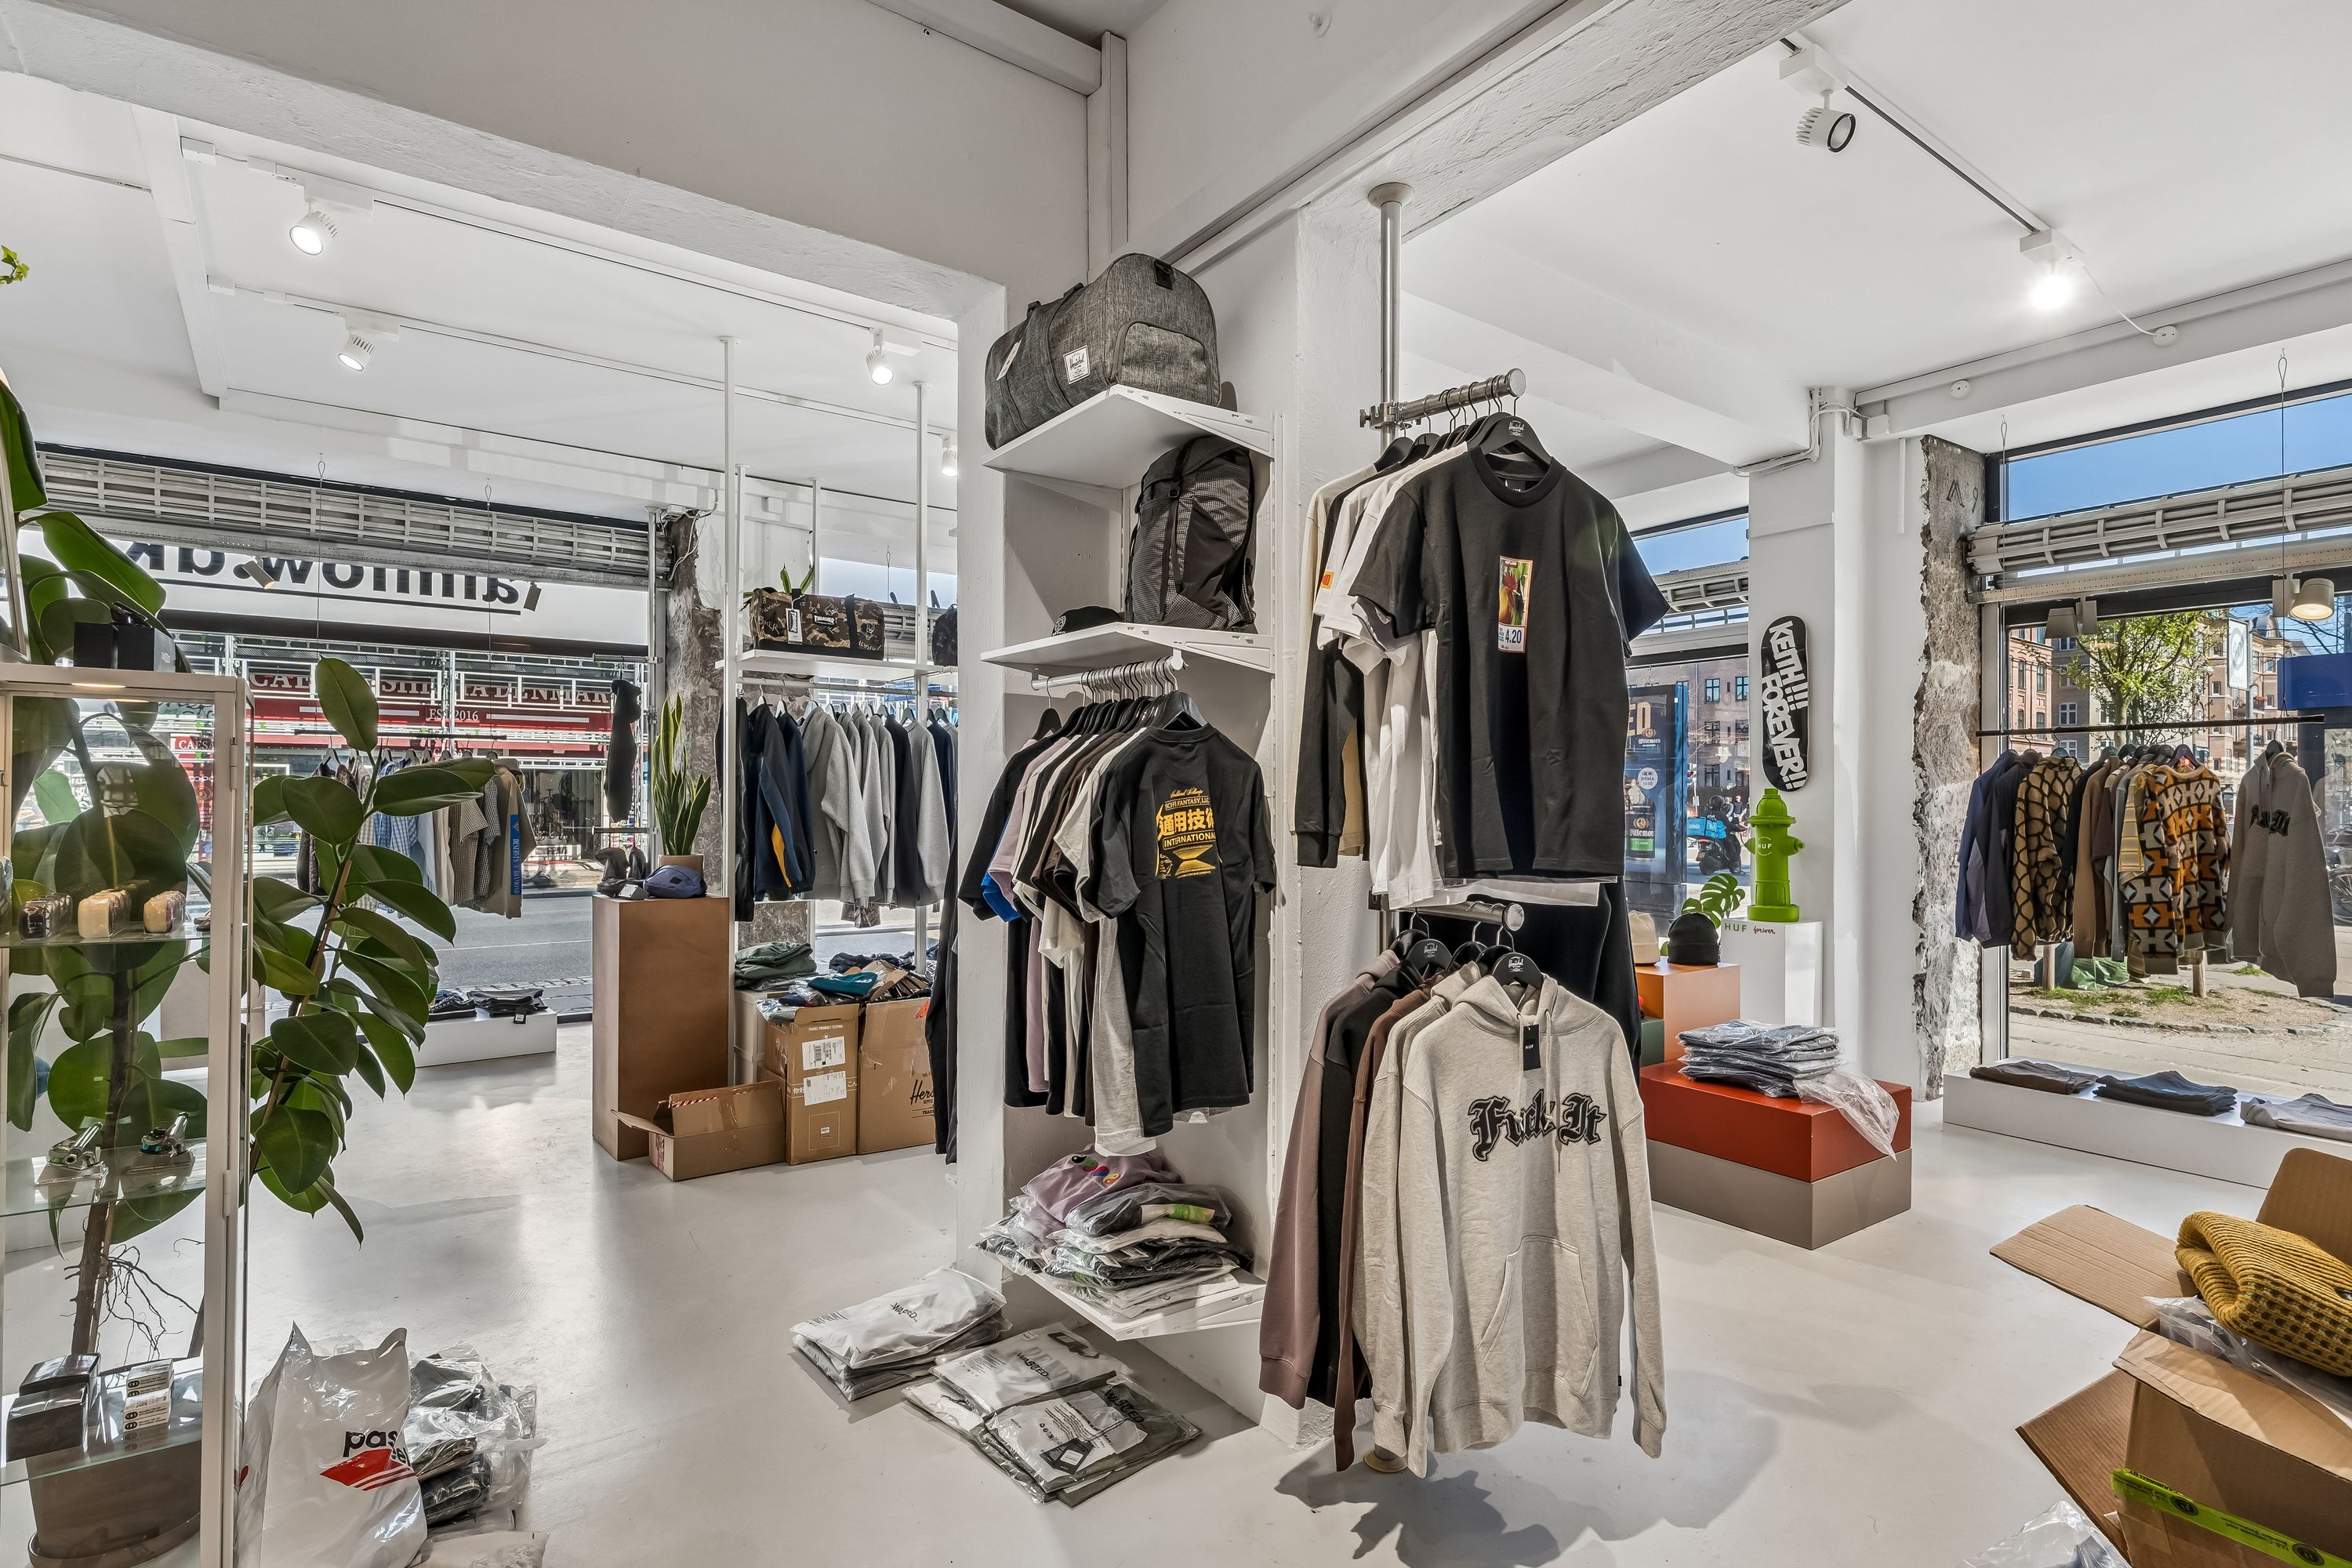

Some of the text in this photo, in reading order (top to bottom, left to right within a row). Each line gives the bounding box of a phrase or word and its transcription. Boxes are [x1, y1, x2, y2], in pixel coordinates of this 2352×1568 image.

[1505, 630, 1522, 644] 4.20
[1769, 620, 1809, 711] KEITH!!!
[455, 710, 478, 720] 2016
[1762, 671, 1808, 790] FOREVER!!
[1725, 923, 1748, 932] HUF
[1468, 1088, 1608, 1162] Fuck It
[1103, 1388, 1145, 1424] WASTED
